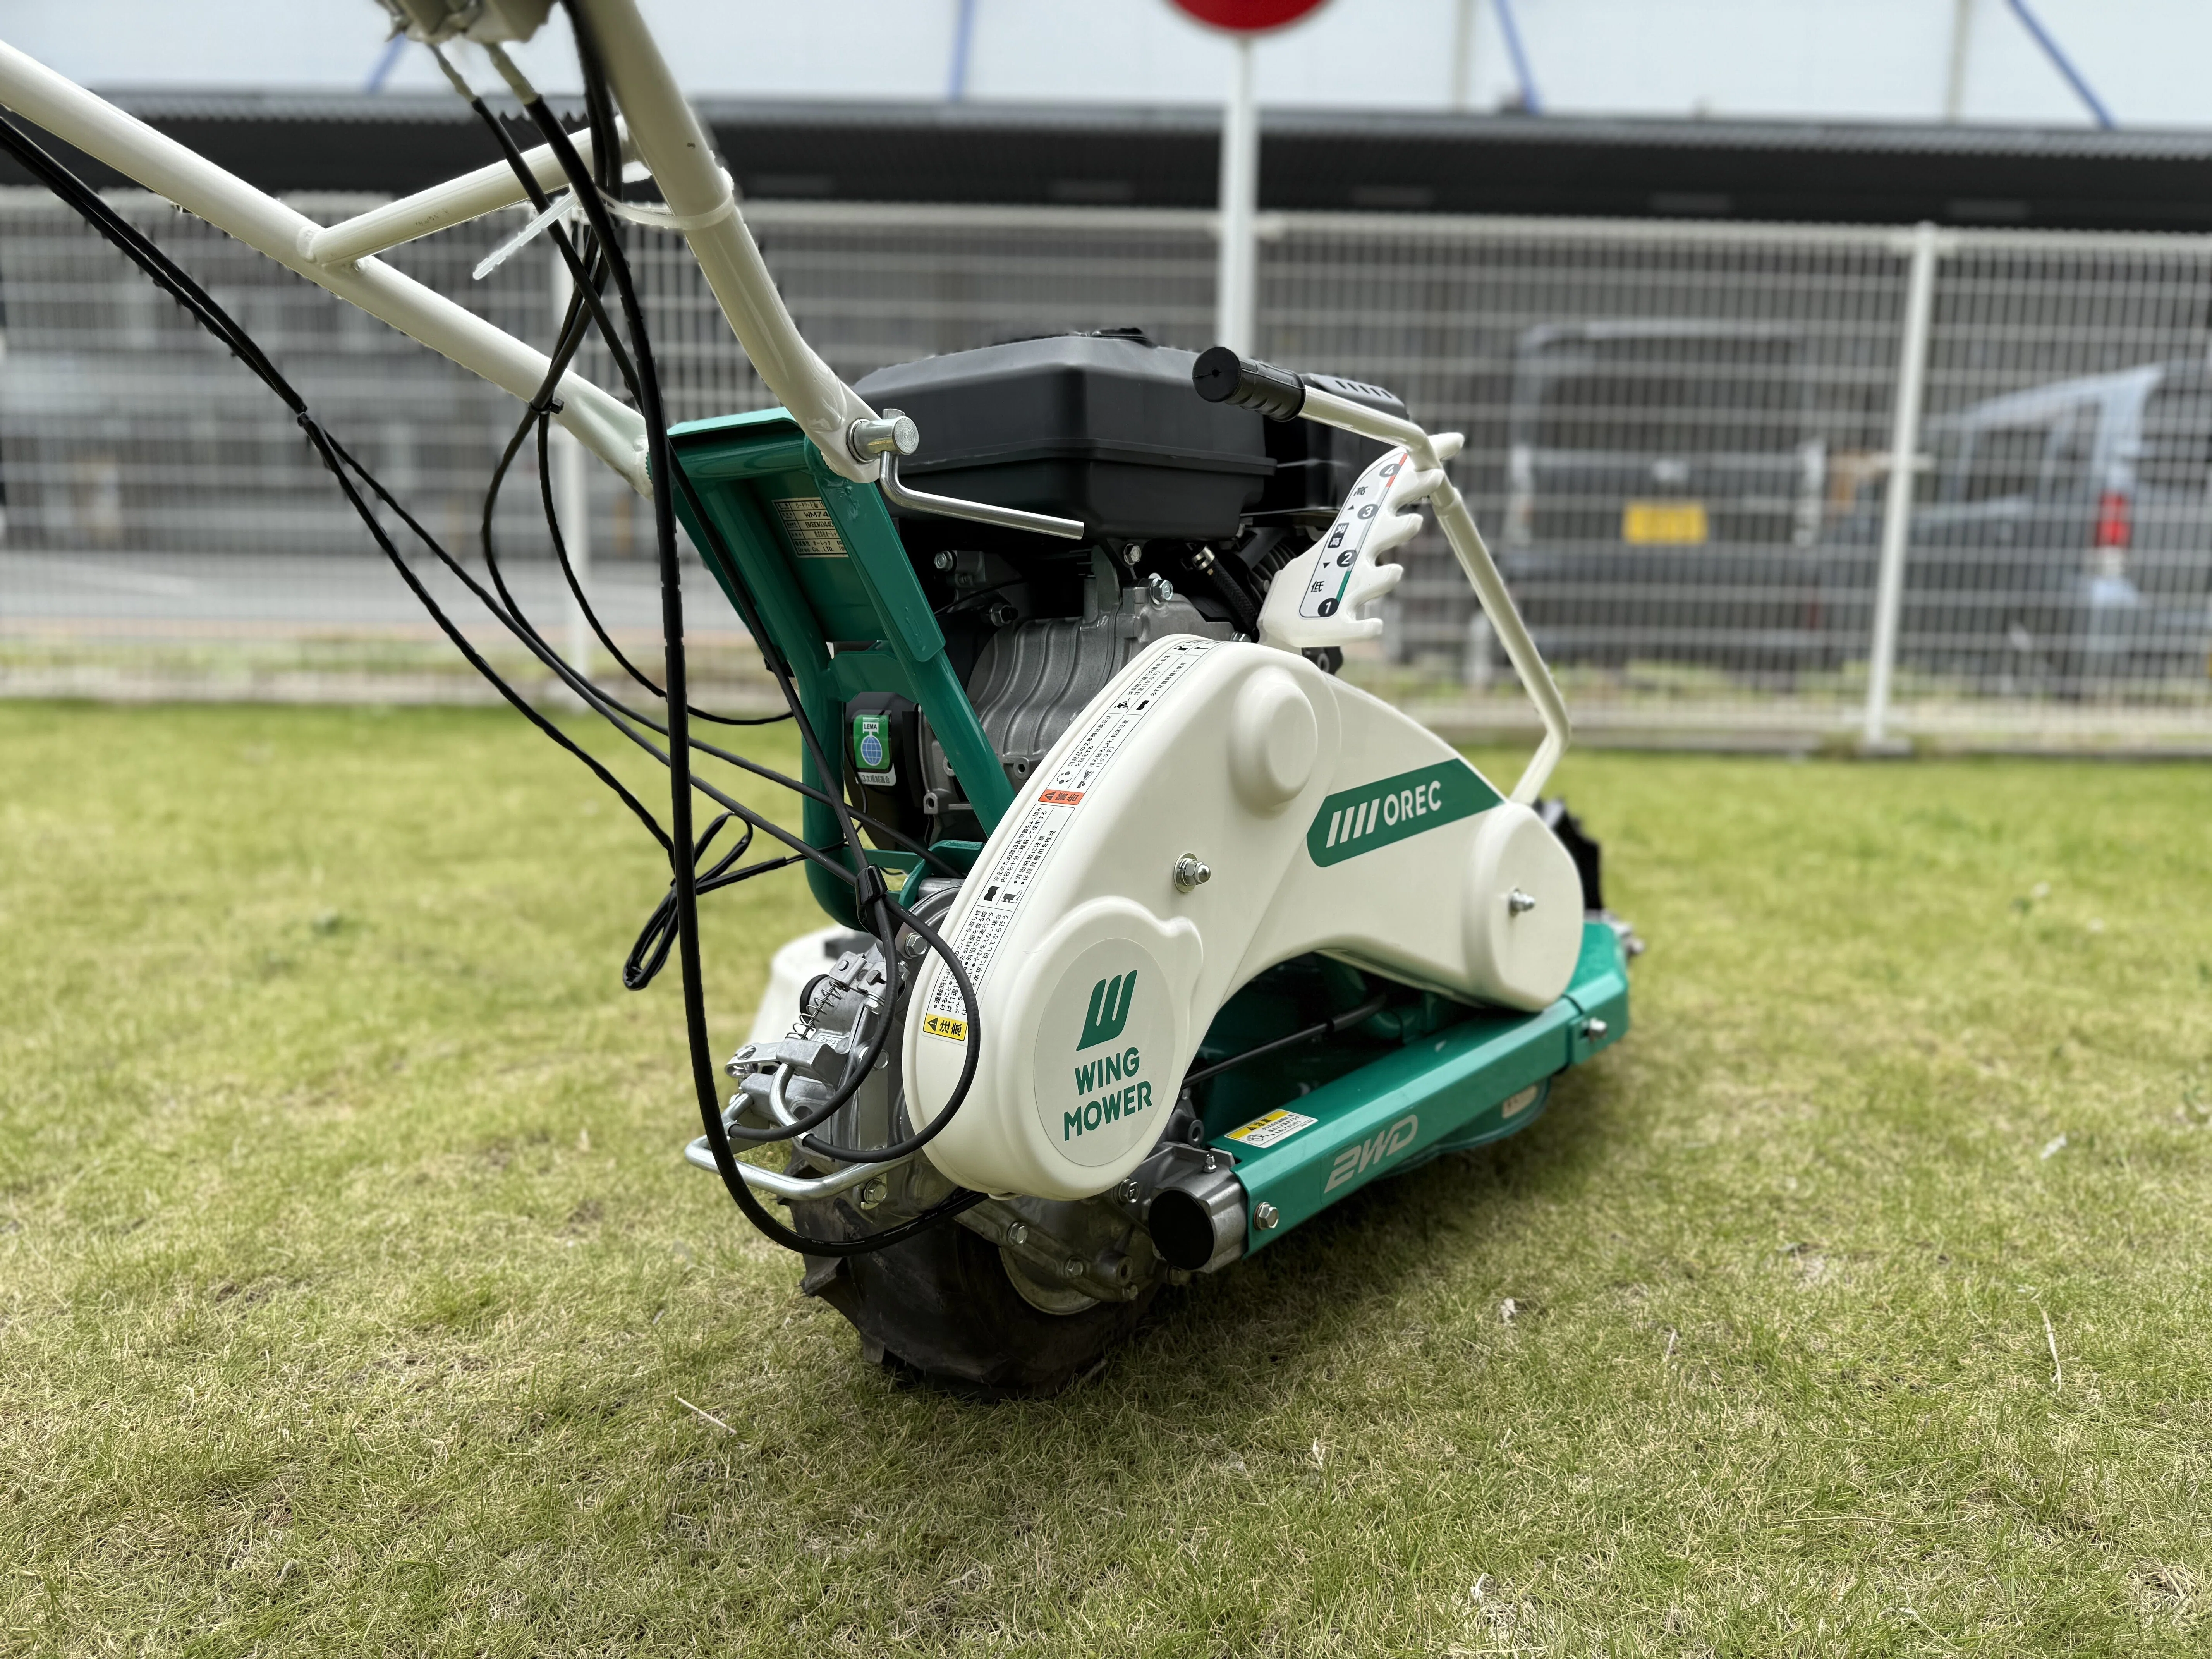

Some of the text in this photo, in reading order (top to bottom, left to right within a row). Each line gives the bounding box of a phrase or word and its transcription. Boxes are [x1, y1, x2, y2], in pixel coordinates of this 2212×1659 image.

[1384, 465, 1393, 475] 4
[1353, 486, 1368, 496] 高
[1362, 507, 1372, 517] 3
[1341, 553, 1352, 565] 2
[1311, 580, 1324, 592] 低
[1324, 602, 1332, 614] 1
[1055, 792, 1079, 802] 警告
[1383, 780, 1441, 826] OREC
[993, 807, 1042, 882] 安全のため取扱説明書をよく読み
[1001, 811, 1047, 883] 内容を十分に理解して使用する
[939, 1021, 962, 1036] 注意
[1075, 1046, 1140, 1096] WING
[1064, 1080, 1152, 1142] MOWER
[1324, 1114, 1419, 1194] 2WD
